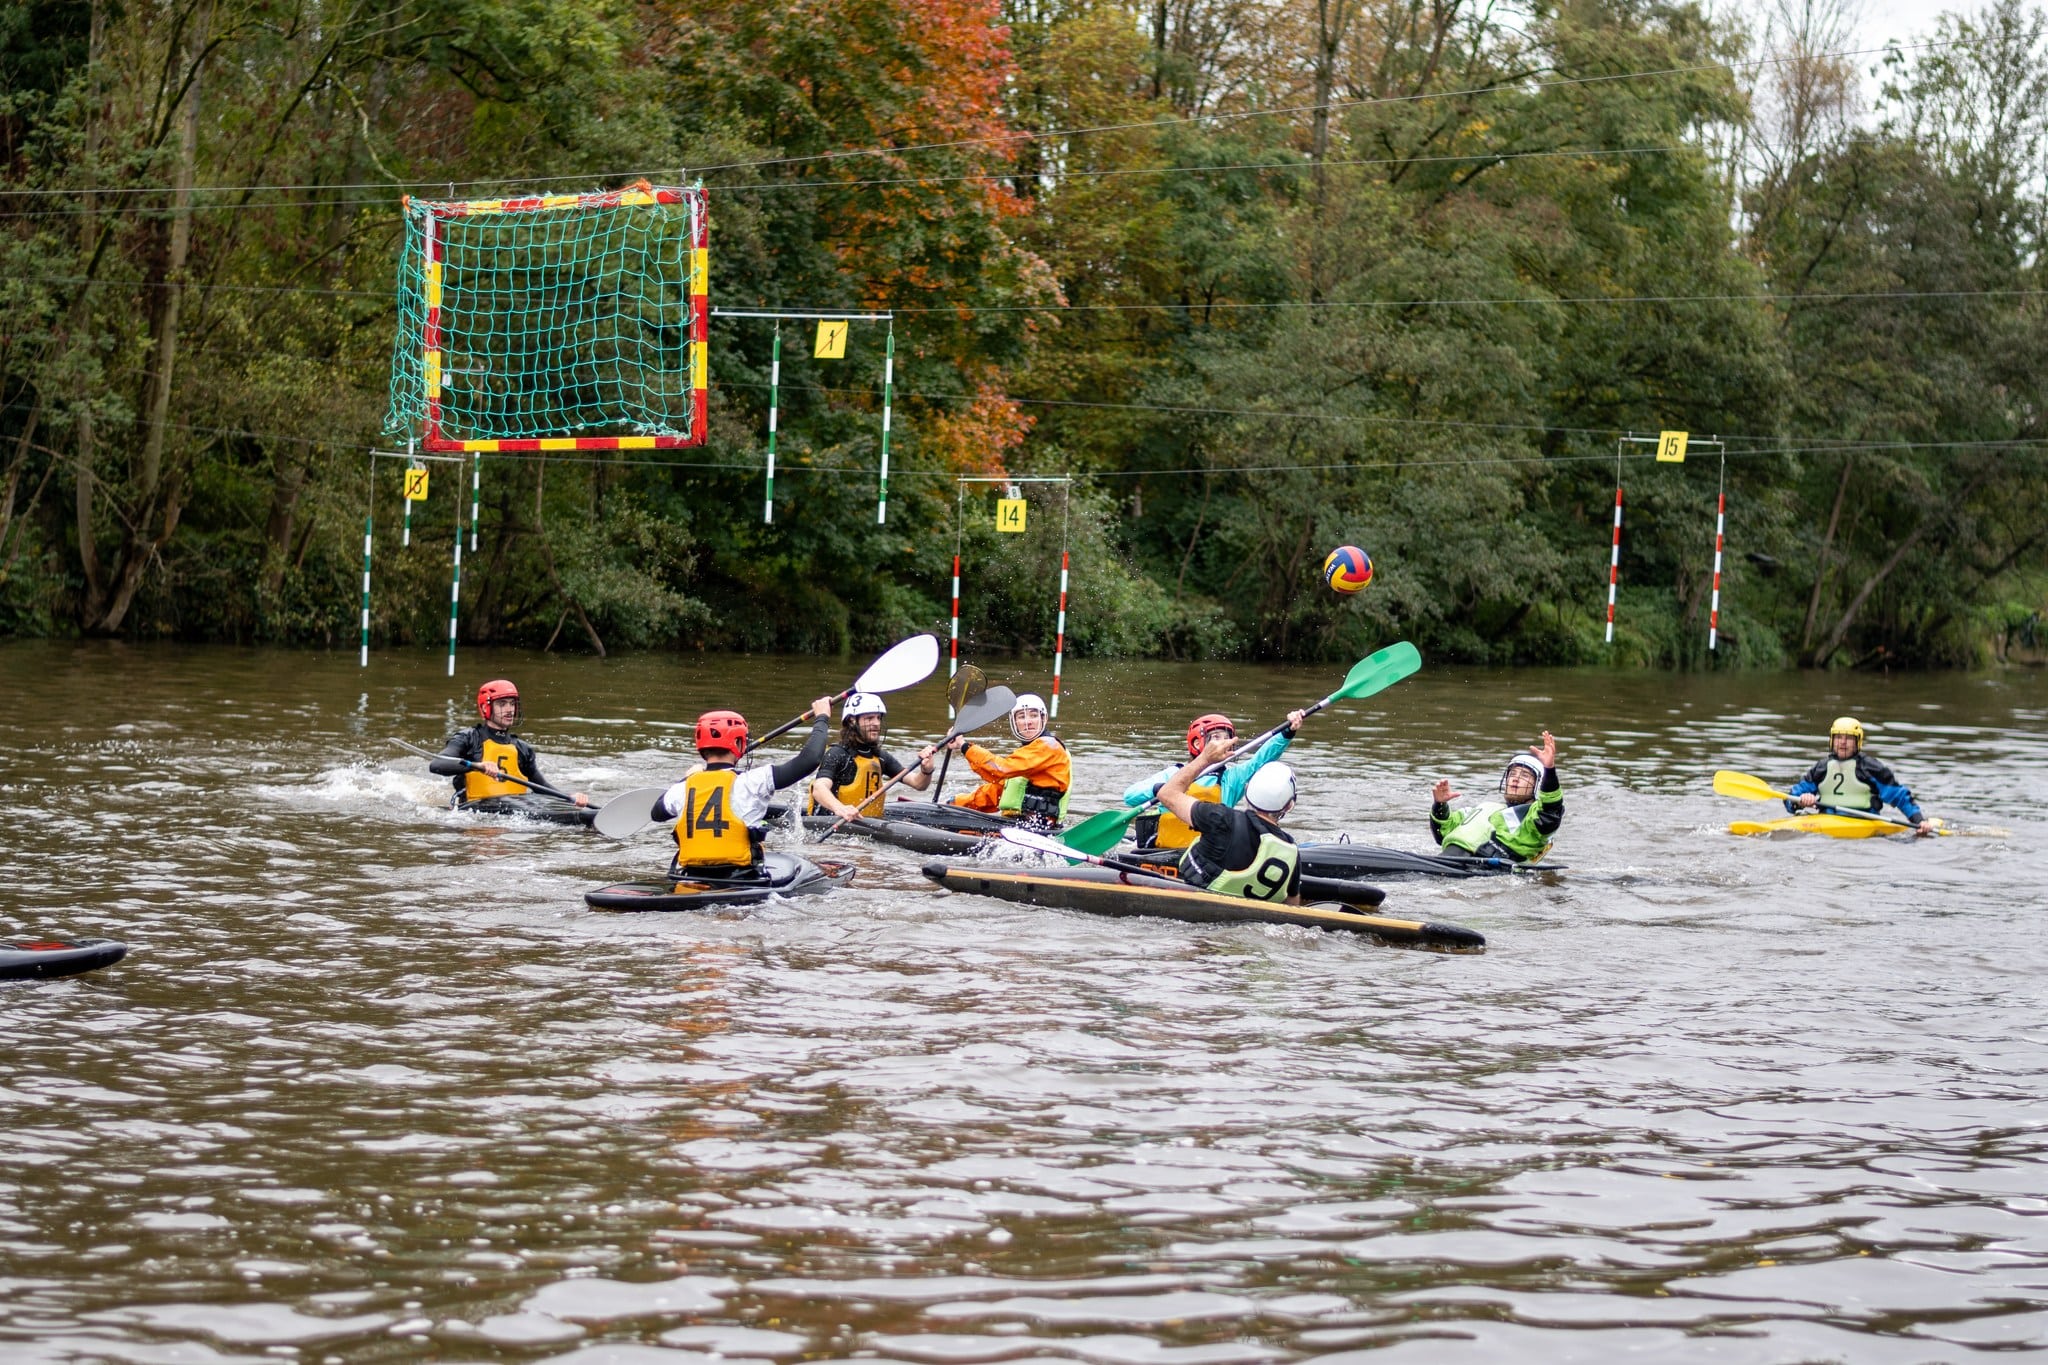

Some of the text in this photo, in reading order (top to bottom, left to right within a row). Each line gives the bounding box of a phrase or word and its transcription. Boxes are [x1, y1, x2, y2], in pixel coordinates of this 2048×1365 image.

[829, 329, 835, 351] 1
[1664, 436, 1679, 456] 15
[409, 474, 422, 494] 13
[1003, 505, 1019, 526] 14
[845, 695, 863, 708] 13
[865, 771, 880, 799] 13
[1833, 772, 1845, 796] 2
[686, 786, 729, 839] 14
[1243, 857, 1290, 900] 9
